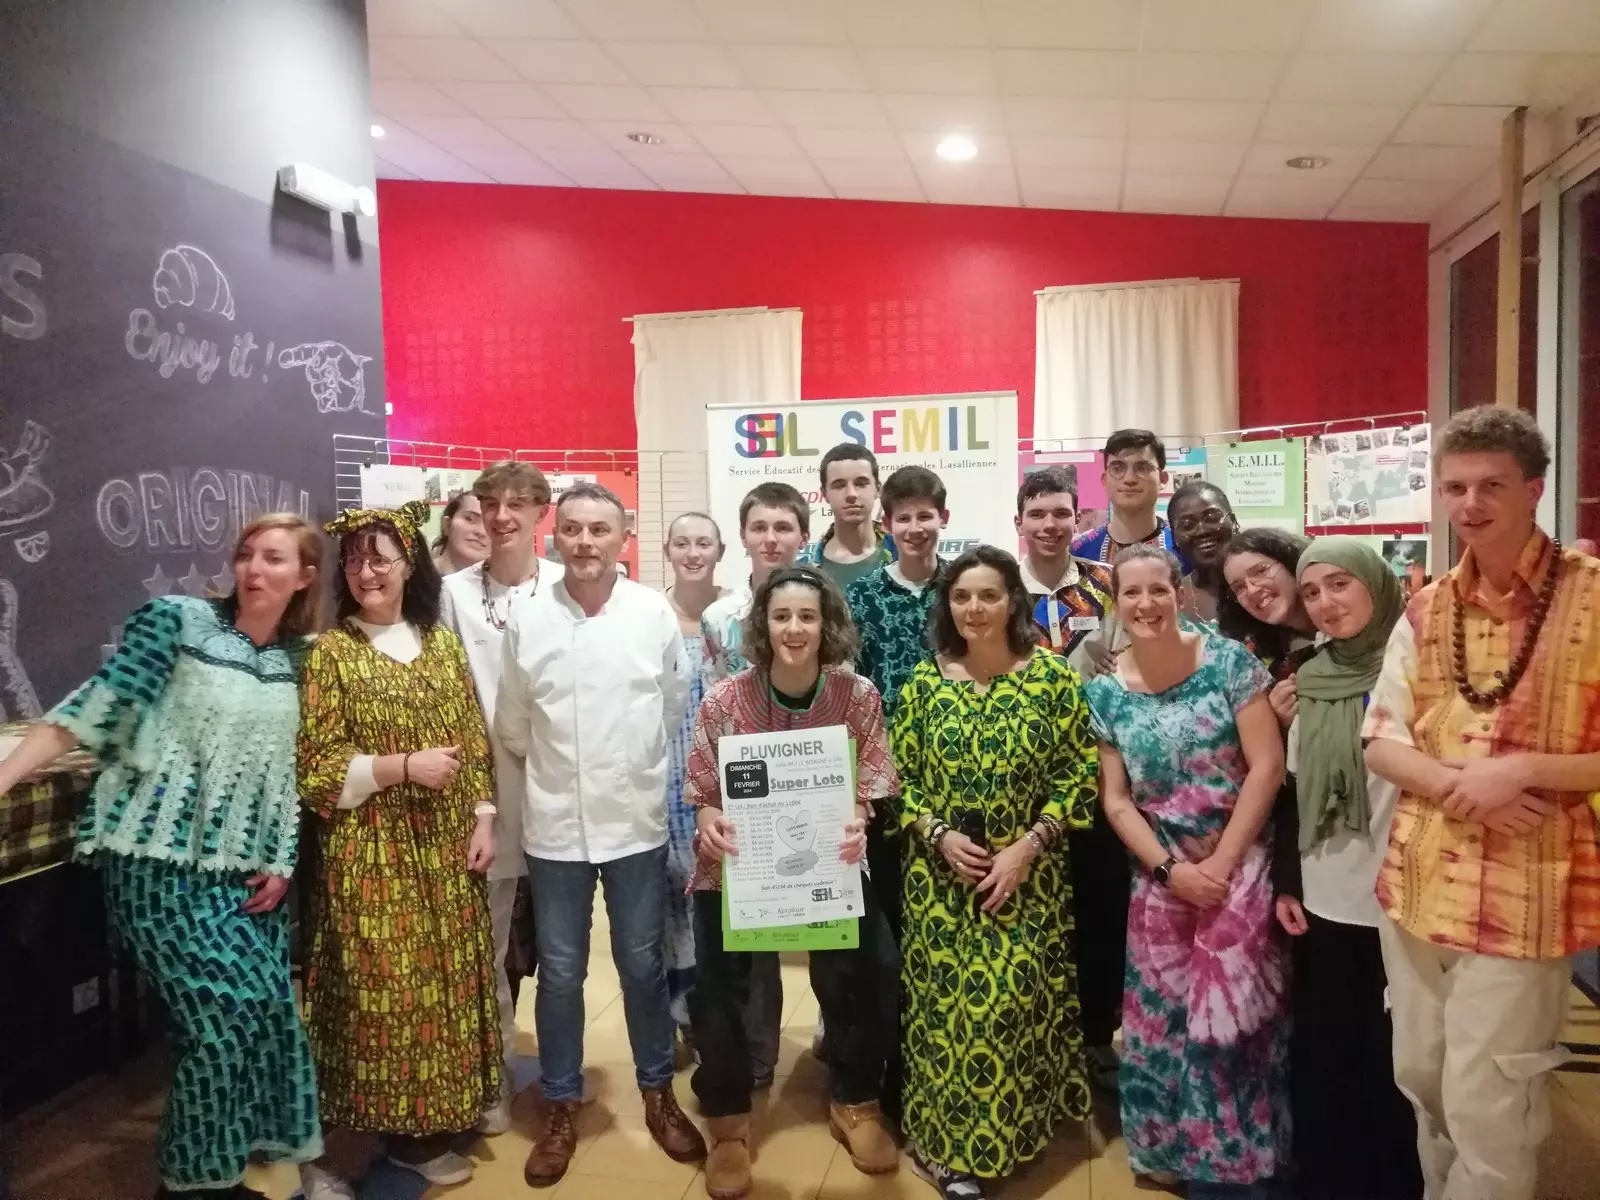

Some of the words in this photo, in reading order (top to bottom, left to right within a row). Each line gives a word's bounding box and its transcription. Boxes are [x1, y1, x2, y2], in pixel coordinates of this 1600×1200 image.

[125, 308, 221, 384] Enjoy
[229, 331, 259, 378] it
[840, 406, 990, 456] SEMIL
[728, 466, 761, 476] Service
[764, 464, 804, 475] Educatif
[806, 466, 821, 474] des
[939, 459, 997, 469] Lasalliennes
[1228, 454, 1285, 468] S.E.M.I.L.
[741, 740, 824, 760] PLUVIGNER
[730, 764, 762, 772] DIMANCHE
[770, 776, 809, 791] Super
[813, 773, 845, 786] Loto
